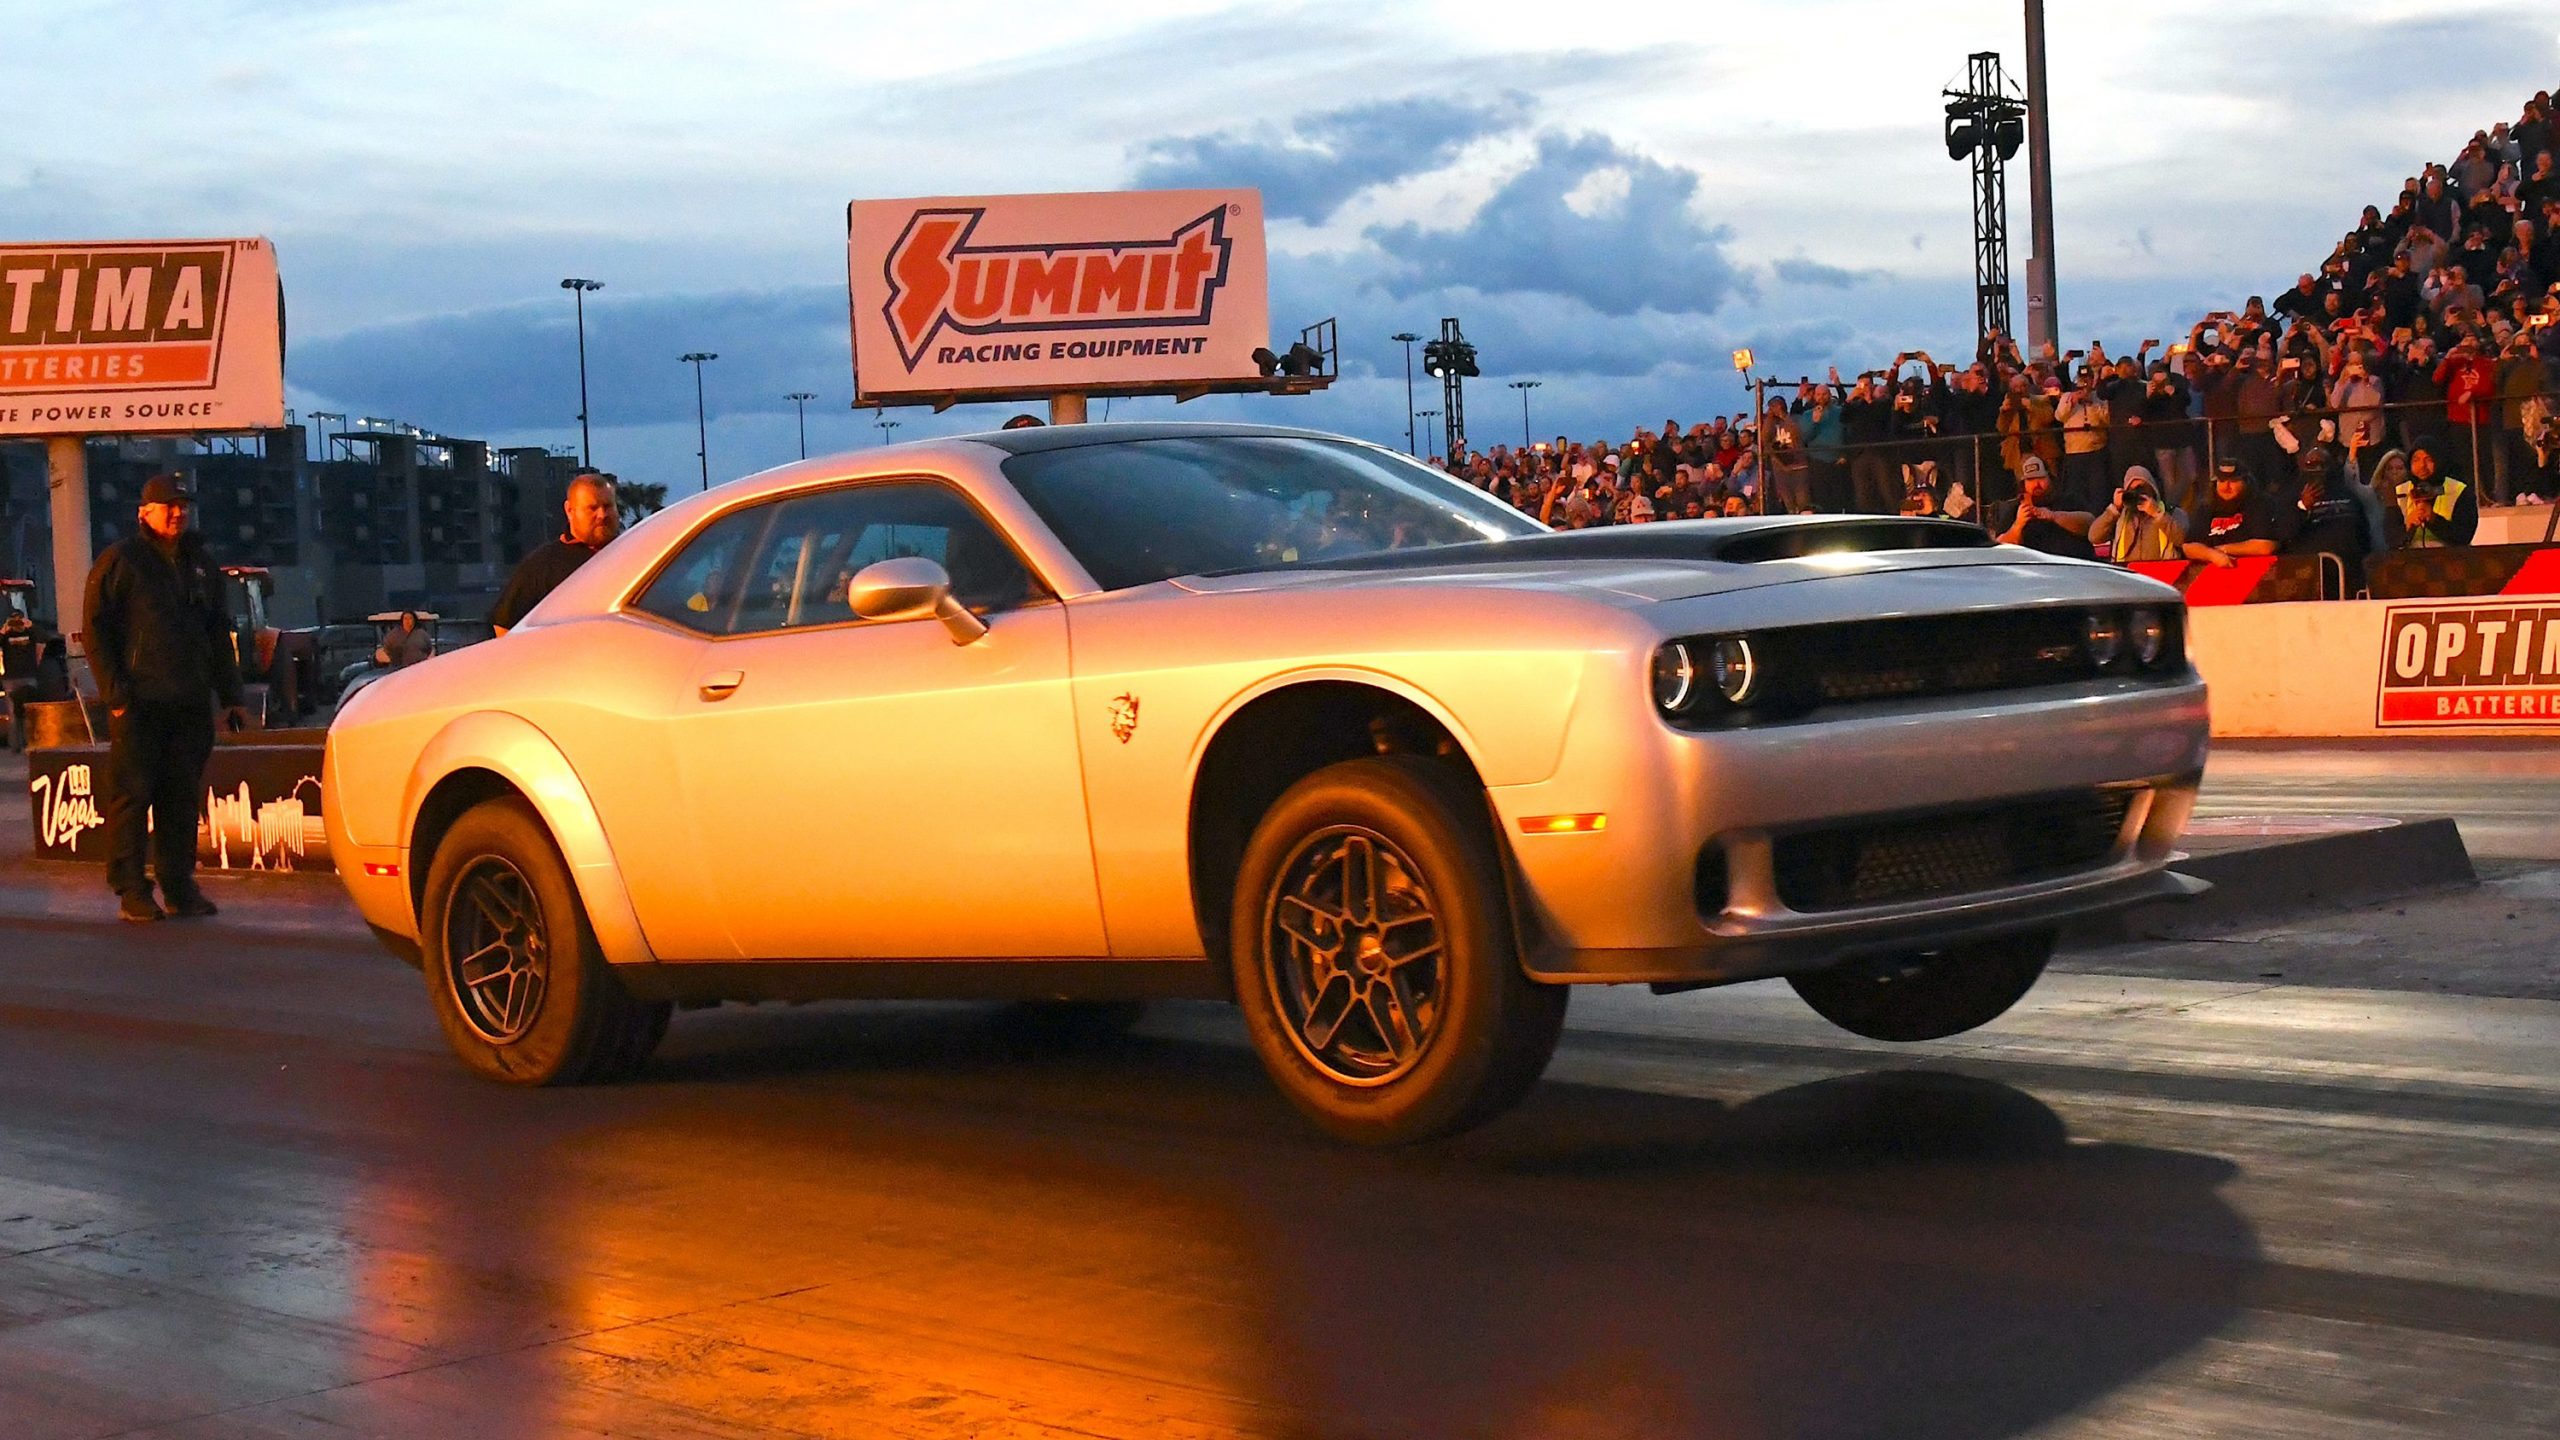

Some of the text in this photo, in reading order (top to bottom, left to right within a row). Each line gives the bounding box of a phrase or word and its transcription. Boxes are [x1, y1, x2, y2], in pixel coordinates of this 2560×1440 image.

[938, 337, 1208, 364] RACING EQUIPMENT
[31, 405, 112, 422] POWER
[124, 401, 212, 419] SOURCE
[67, 764, 91, 795] LAS
[31, 770, 104, 852] Vegas
